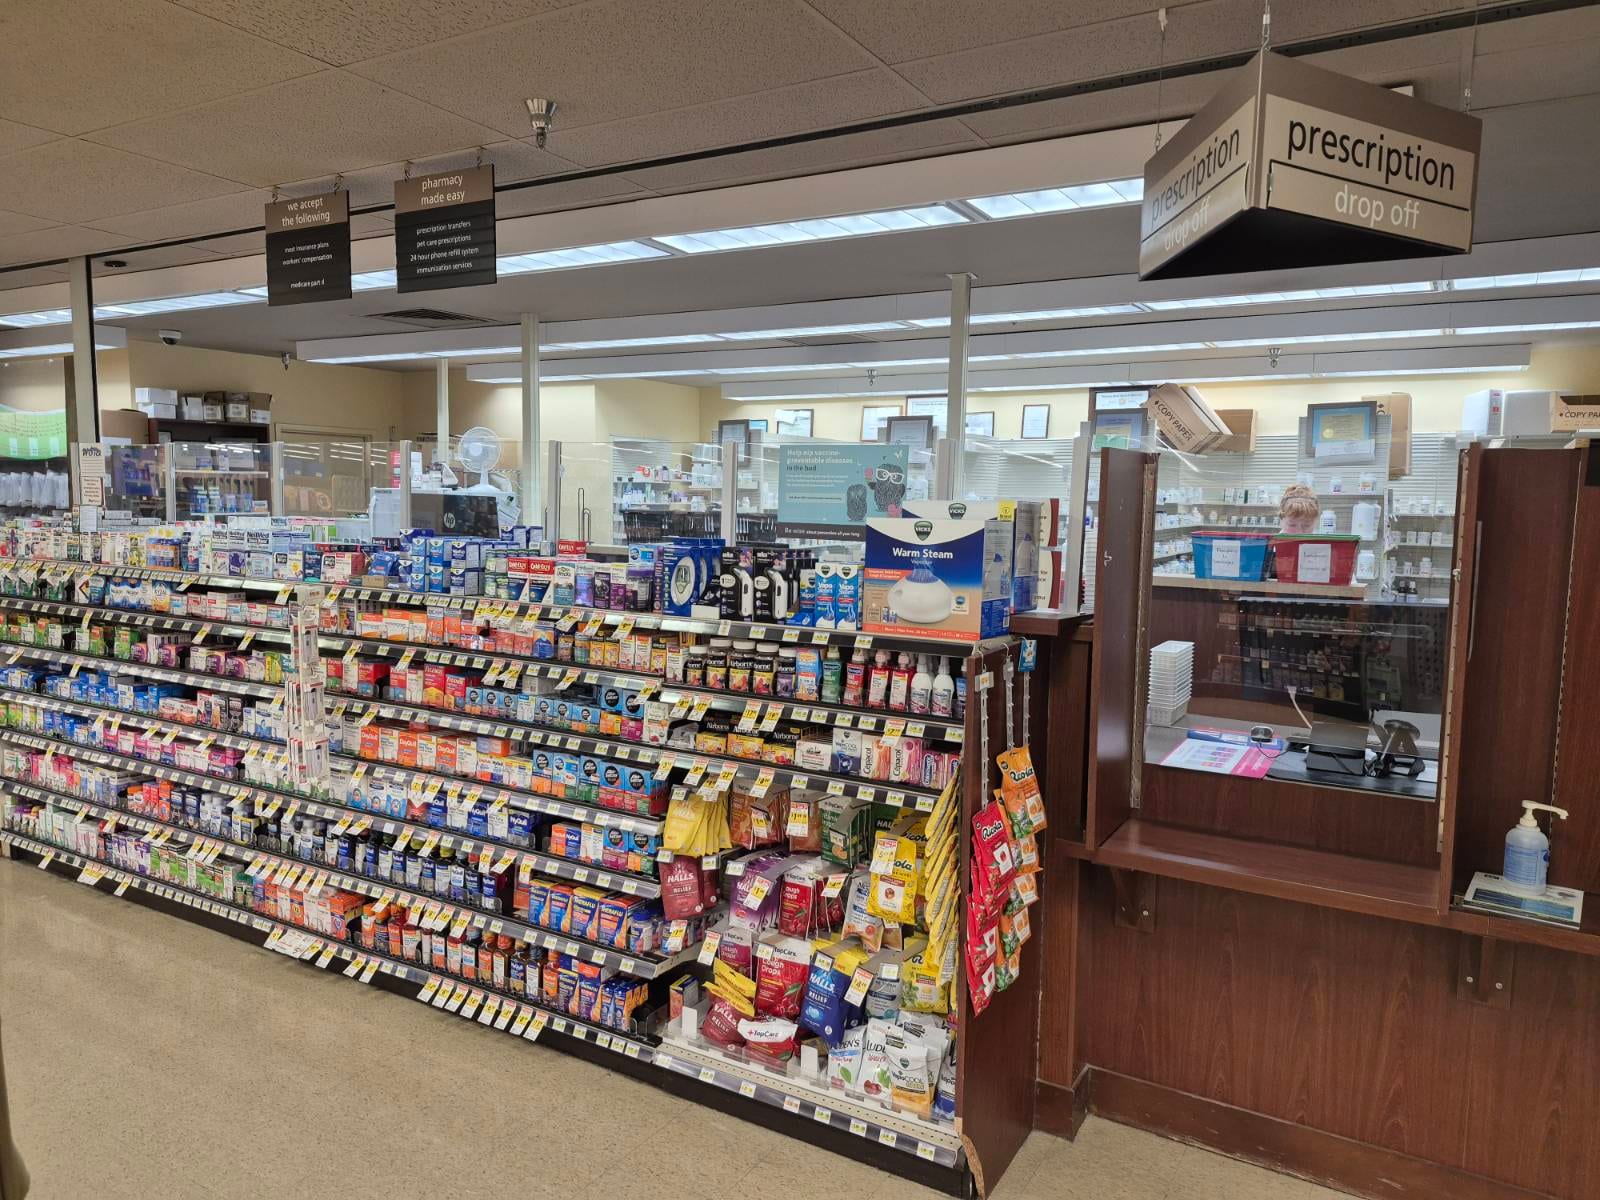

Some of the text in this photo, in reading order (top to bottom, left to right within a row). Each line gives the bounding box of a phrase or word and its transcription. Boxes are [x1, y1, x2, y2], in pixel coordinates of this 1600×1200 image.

[1286, 118, 1455, 191] prescription
[421, 174, 463, 193] pharmacy
[1151, 129, 1240, 231] prescription
[420, 190, 466, 206] made easy
[287, 198, 323, 212] we accept
[1334, 184, 1420, 230] drop off
[281, 210, 331, 227] the following
[1164, 195, 1212, 252] drop off
[416, 220, 472, 236] prescription transfers
[296, 243, 317, 252] insurance
[317, 241, 330, 250] plans
[416, 234, 472, 249] pet care prescriptions
[301, 253, 333, 264] compensation
[410, 246, 480, 262] 24 hour phone refill system
[416, 261, 473, 274] immunization services
[290, 280, 310, 289] medicare
[310, 279, 320, 287] part
[1157, 403, 1193, 441] COPY PAPER
[786, 456, 825, 465] preventable
[804, 464, 817, 472] bud
[246, 531, 270, 539] NeilMed
[892, 547, 954, 560] Warm Steam
[773, 731, 801, 741] Airborne
[399, 738, 417, 748] DayQuil
[863, 747, 873, 775] Cepacol
[892, 748, 902, 777] Cepacol
[1010, 767, 1034, 782] Ricola
[510, 816, 527, 826] NyQuil
[566, 833, 580, 842] NyQuil
[982, 822, 1002, 840] Ricola
[667, 873, 694, 883] HALLS
[774, 947, 797, 957] TopCare
[762, 958, 785, 969] Cough
[761, 965, 781, 976] Drops
[810, 973, 837, 993] HALLS
[808, 991, 828, 1005] RELIEF
[753, 1030, 779, 1039] TopCare
[891, 1071, 923, 1084] VapoCOOL
